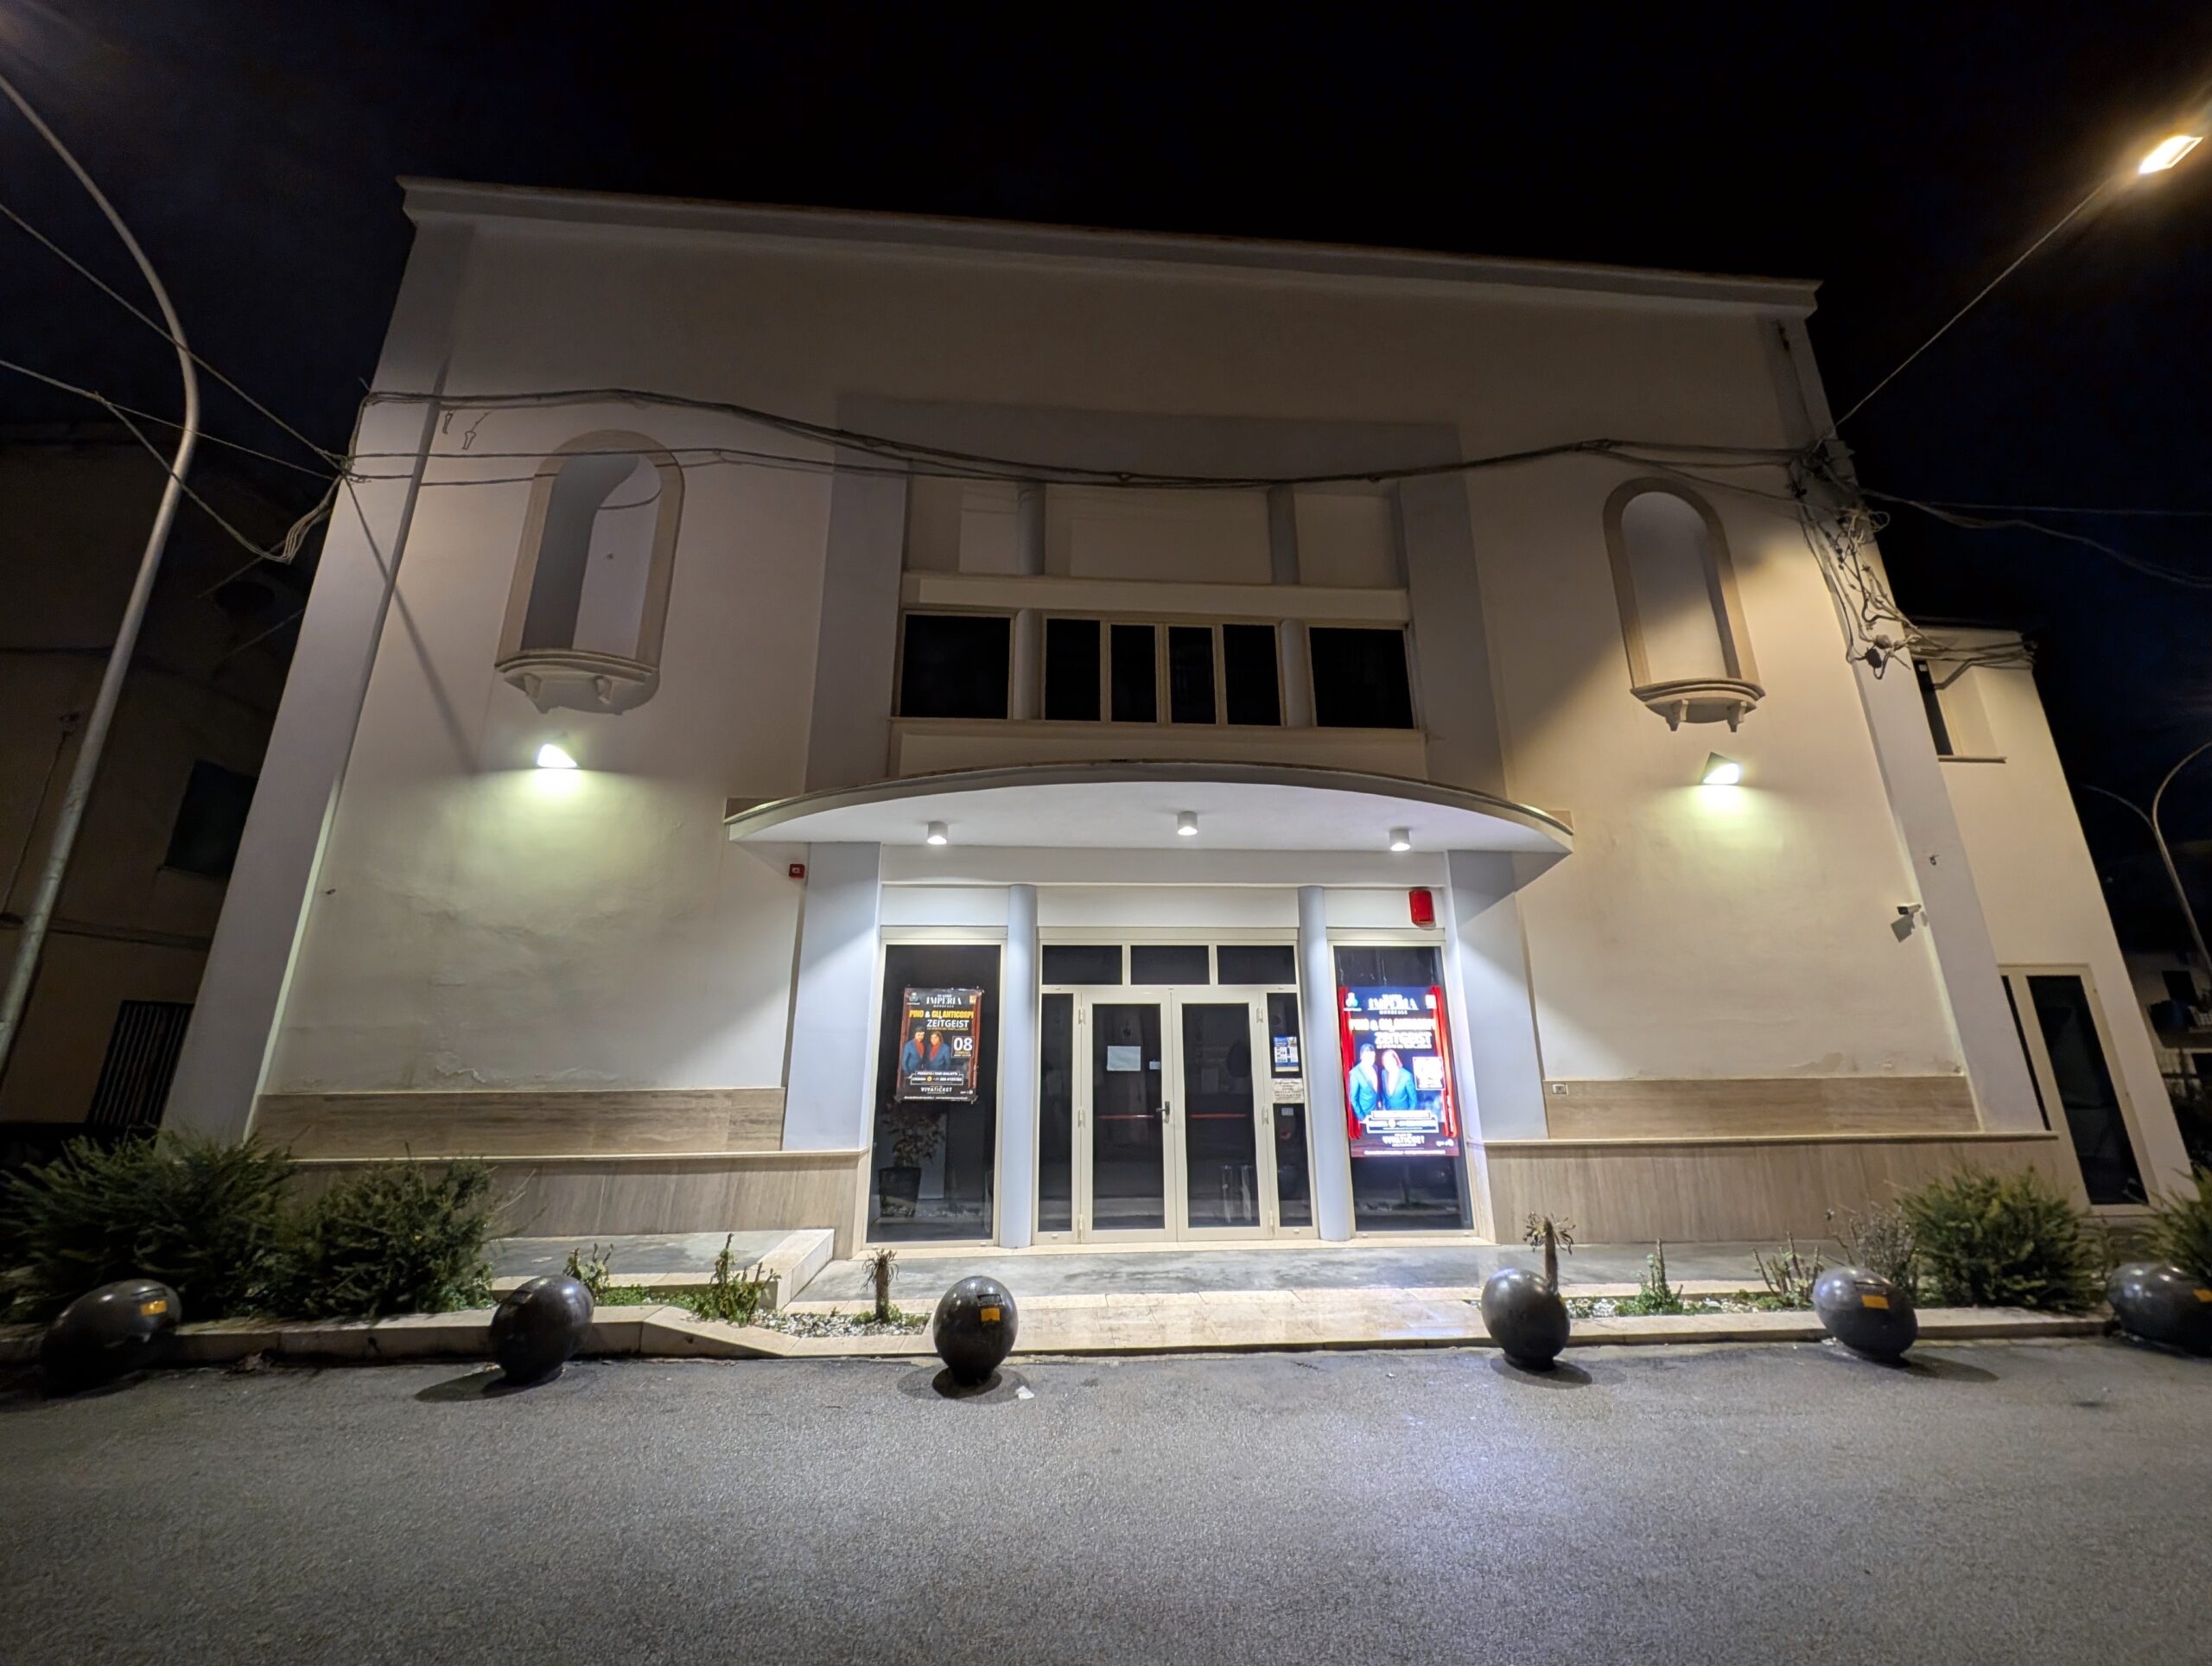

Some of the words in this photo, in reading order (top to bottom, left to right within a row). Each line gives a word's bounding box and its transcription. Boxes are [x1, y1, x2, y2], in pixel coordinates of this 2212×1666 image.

[926, 996, 963, 1005] IMPERIA
[909, 1009, 925, 1018] PINO
[942, 1010, 975, 1019] ANTICORPI
[953, 1037, 973, 1051] 08
